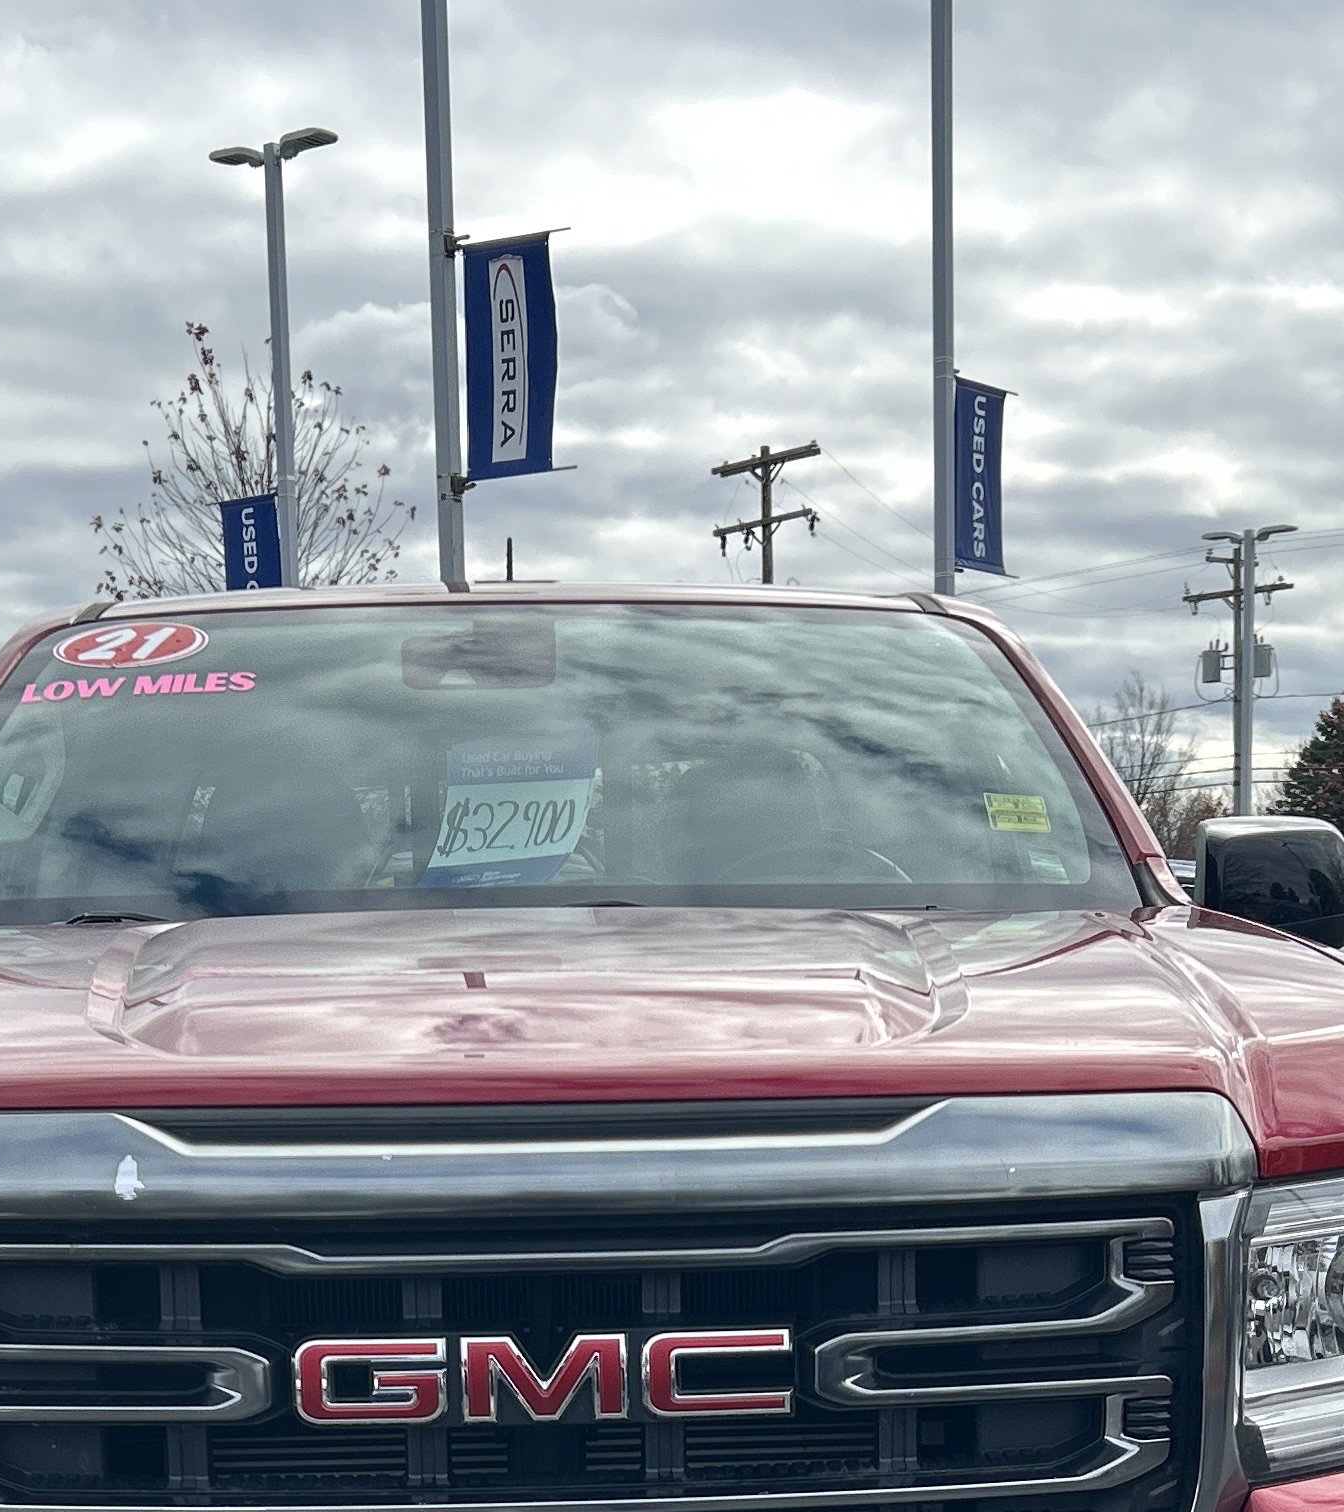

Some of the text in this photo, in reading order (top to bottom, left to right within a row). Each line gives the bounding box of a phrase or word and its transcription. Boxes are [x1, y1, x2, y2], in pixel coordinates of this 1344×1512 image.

[497, 297, 516, 449] SERRA
[971, 396, 986, 558] USED CARS
[240, 506, 258, 575] USED
[76, 626, 178, 661] 21
[20, 671, 257, 704] LOW MILES
[461, 767, 494, 778] That's
[524, 765, 542, 776] for
[462, 750, 553, 763] Used Car Buying
[291, 1328, 794, 1425] GMC
